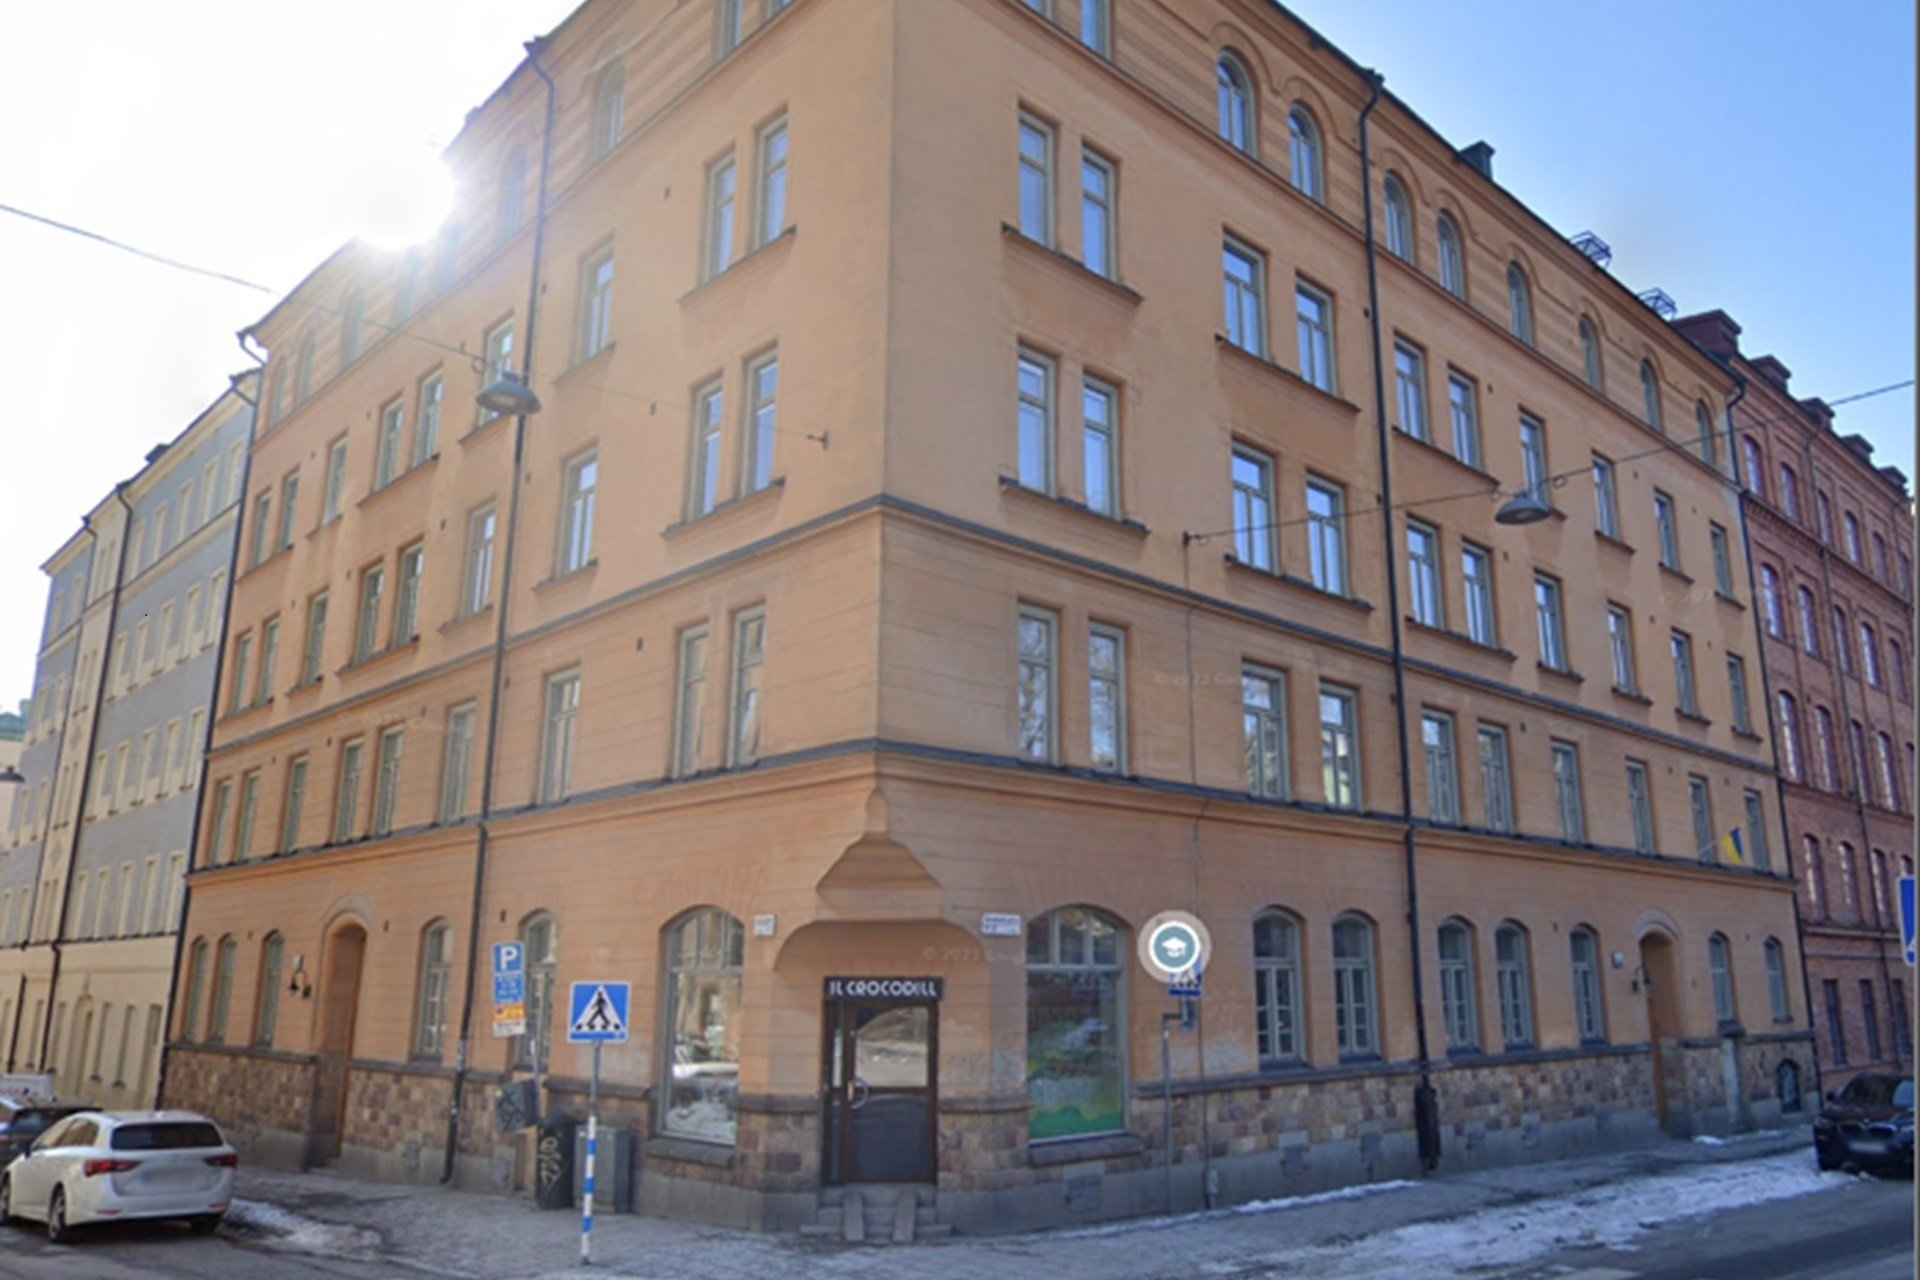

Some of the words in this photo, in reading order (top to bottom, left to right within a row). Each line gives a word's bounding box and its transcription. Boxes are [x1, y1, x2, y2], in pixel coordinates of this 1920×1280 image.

[500, 946, 518, 971] P
[829, 980, 844, 996] IL
[845, 979, 938, 997] CROCODILL
